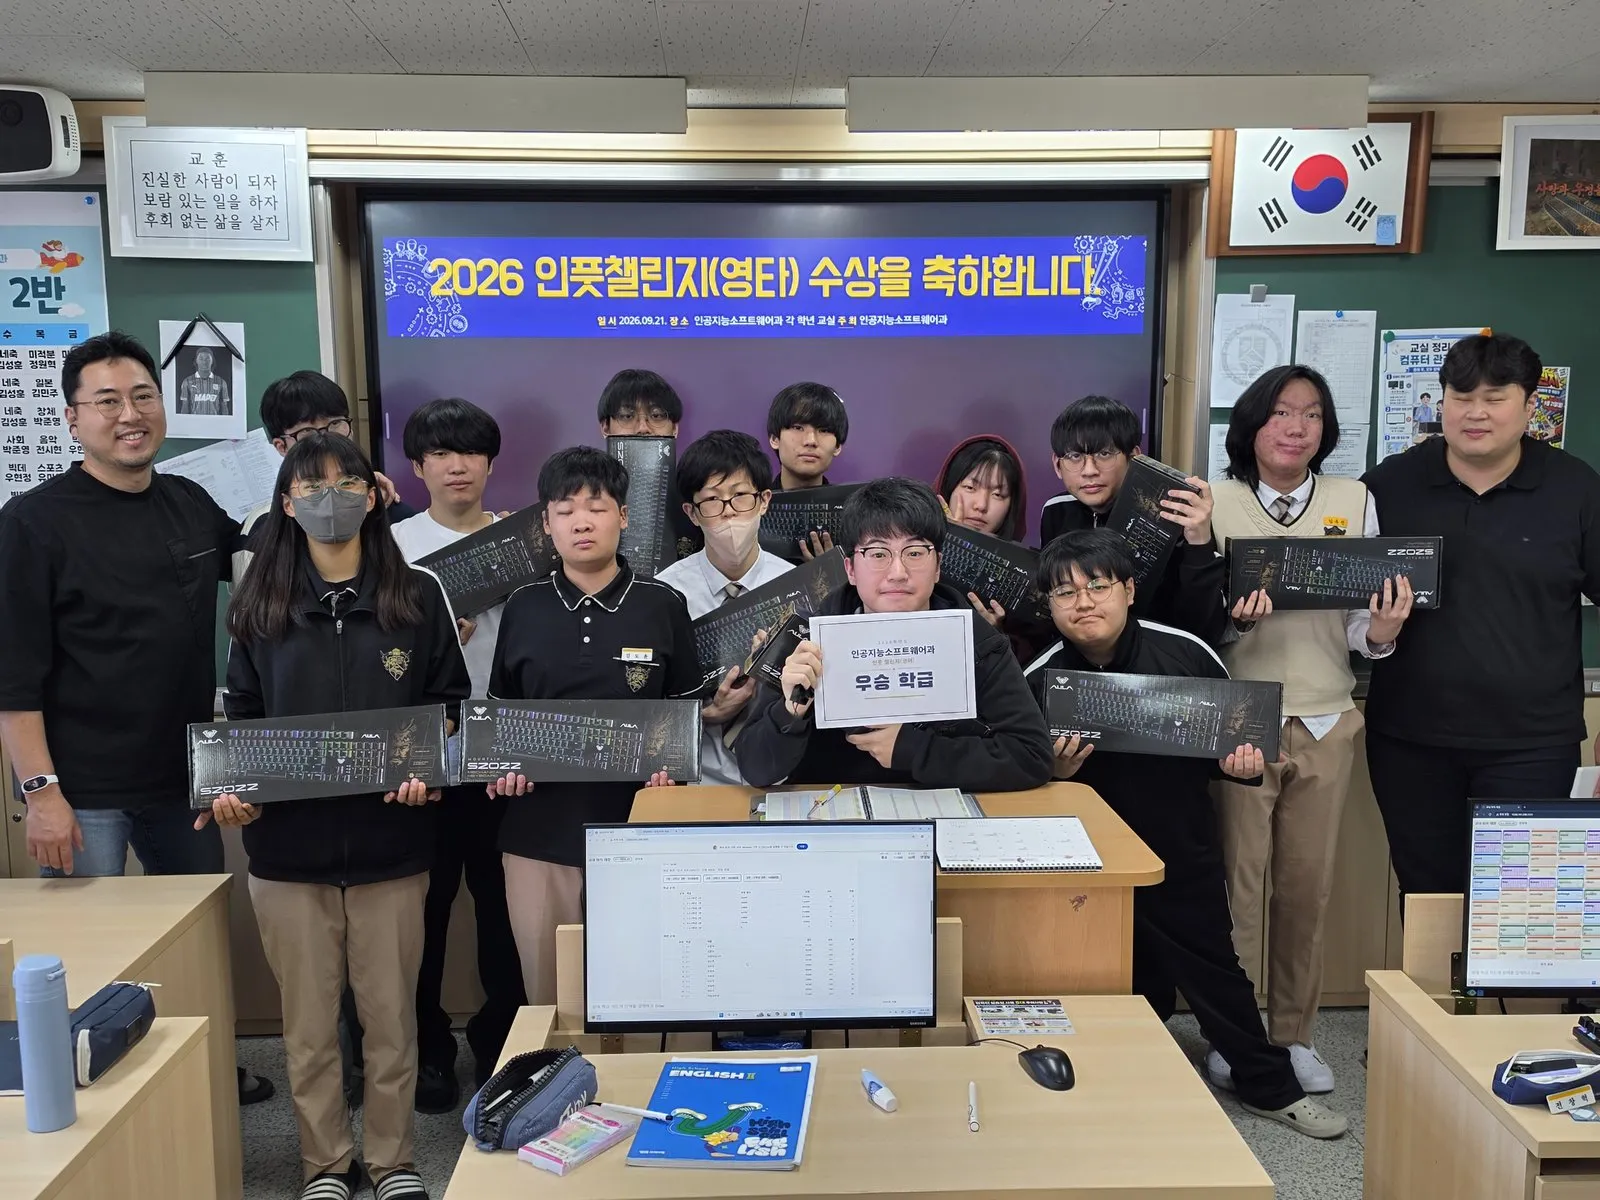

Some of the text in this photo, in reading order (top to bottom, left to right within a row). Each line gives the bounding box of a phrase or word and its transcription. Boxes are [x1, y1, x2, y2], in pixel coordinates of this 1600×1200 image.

[188, 152, 228, 168] 교 훈
[142, 171, 277, 191] 진실한 사람이 되자
[143, 192, 278, 211] 보람 있는 일을 하자
[144, 211, 279, 231] 후회 없는 삶을 살자
[429, 258, 524, 297] 2026
[535, 255, 799, 298] 인풋챌린지(영타)
[809, 255, 912, 298] 수상을
[9, 276, 66, 314] 2반
[619, 316, 667, 325] 2026.09.21.
[694, 315, 783, 326] 인공지능소프트웨어과
[785, 315, 795, 326] 각
[797, 315, 815, 326] 학년
[816, 315, 836, 326] 교실
[860, 315, 948, 325] 인공지능소프트웨어과
[2, 329, 12, 339] 수
[36, 329, 45, 339] 목
[68, 329, 78, 339] 금
[1410, 343, 1429, 353] 교실
[28, 350, 55, 359] 미적분
[1400, 354, 1430, 365] 컴퓨터
[35, 378, 53, 387] 일본
[31, 388, 59, 398] 김민주
[37, 407, 56, 416] 창체
[6, 435, 25, 444] 사회
[39, 435, 58, 444] 음악
[37, 463, 63, 472] 스포츠
[851, 645, 935, 659] 인공지능소프트웨어과
[855, 671, 934, 691] 우승 학급
[669, 1070, 745, 1079] ENGLISH
